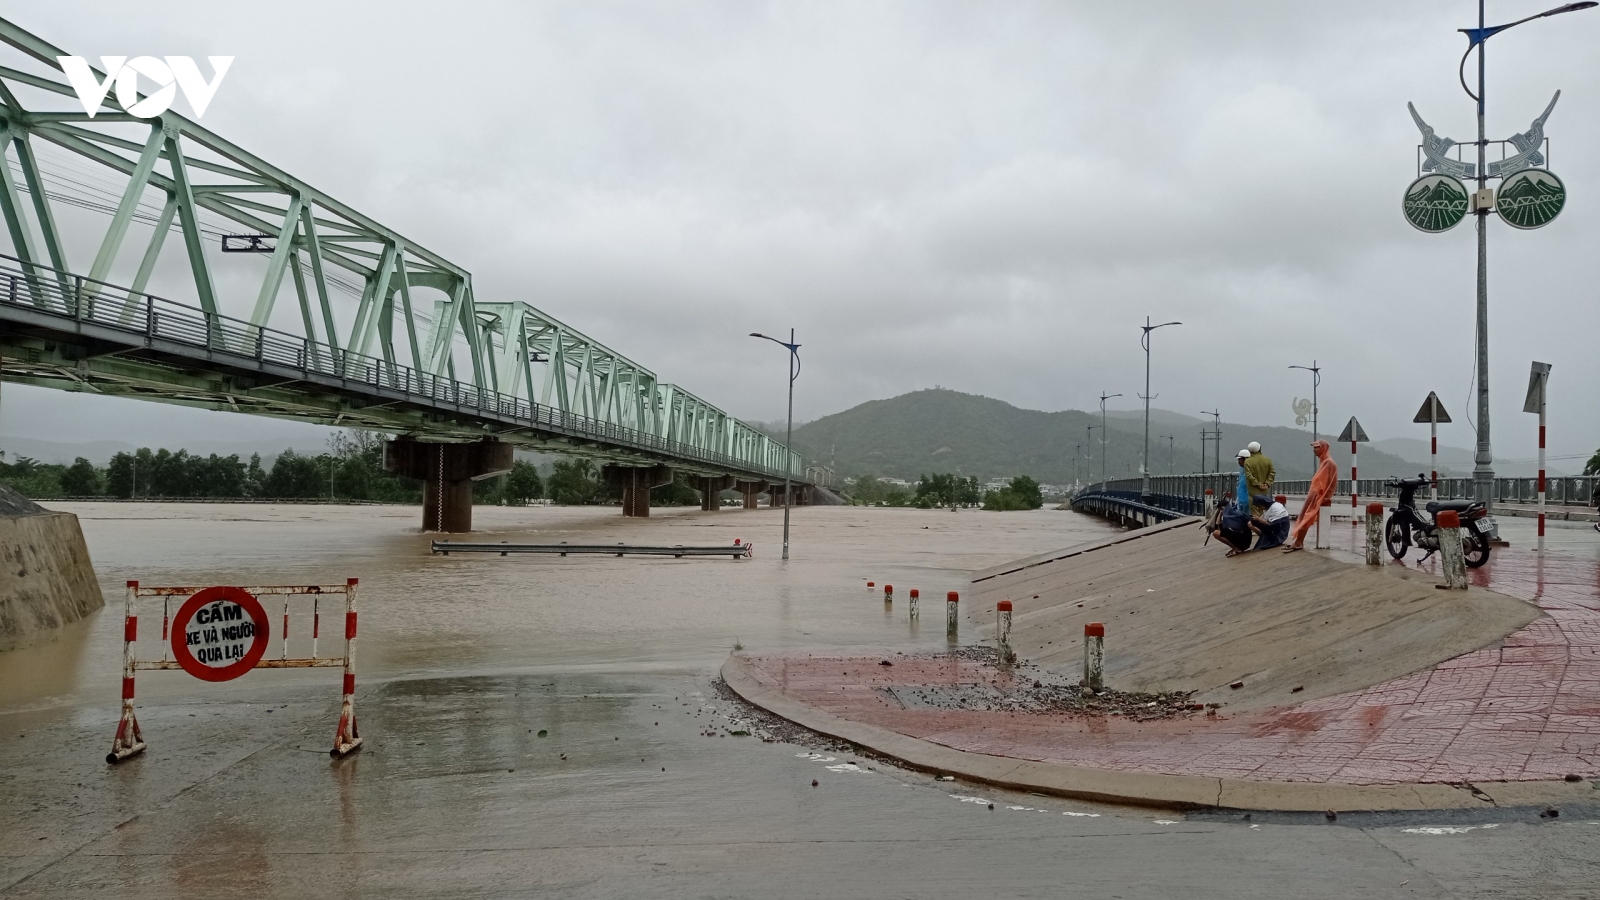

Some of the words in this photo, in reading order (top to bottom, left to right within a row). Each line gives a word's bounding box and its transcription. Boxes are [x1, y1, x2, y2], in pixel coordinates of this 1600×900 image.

[196, 602, 242, 624] CẤM
[186, 631, 201, 645] XE
[203, 626, 218, 643] VÀ
[197, 647, 223, 664] QUA
